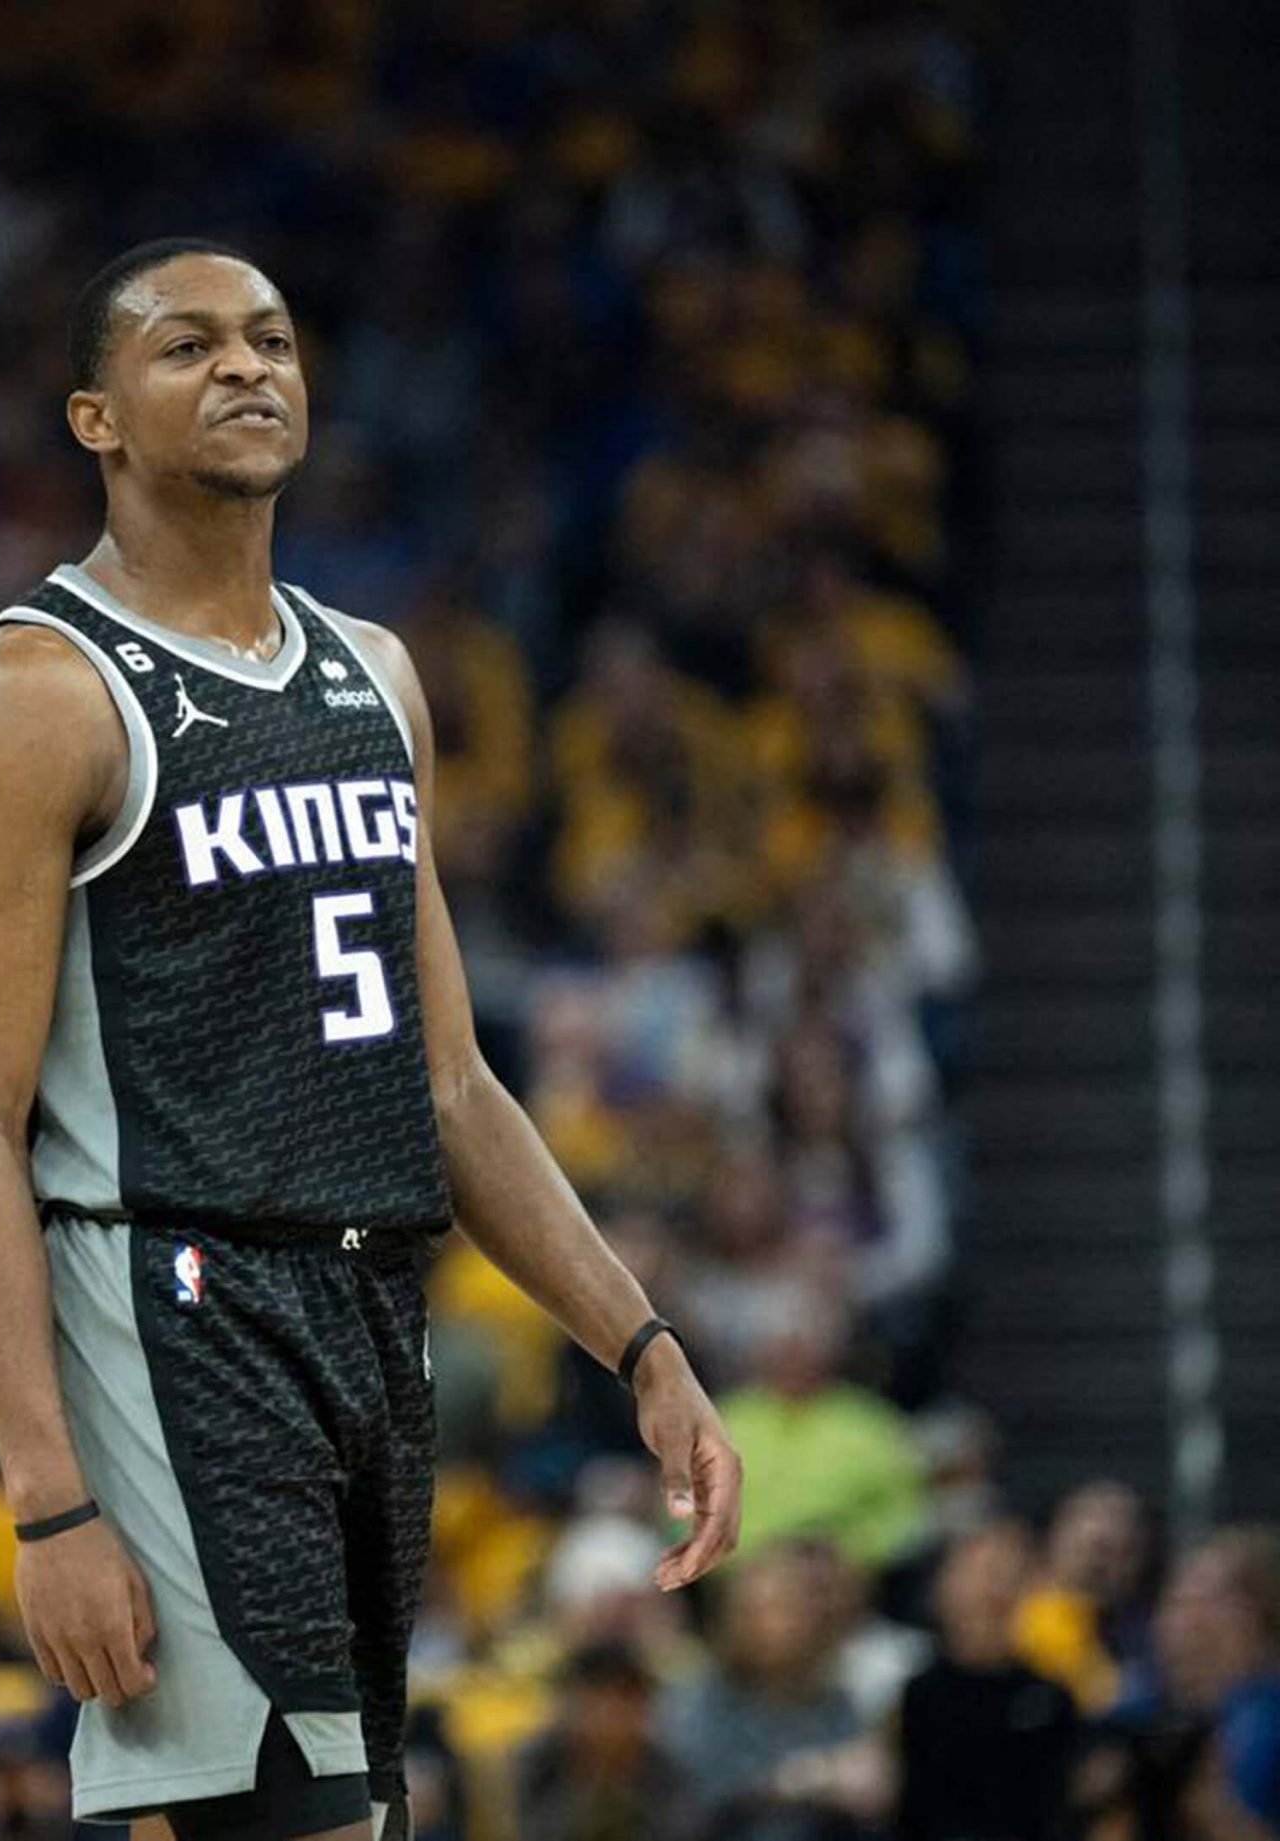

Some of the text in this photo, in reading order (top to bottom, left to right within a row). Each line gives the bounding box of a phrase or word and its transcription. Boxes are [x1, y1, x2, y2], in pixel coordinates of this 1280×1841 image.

[115, 641, 156, 673] 6
[175, 778, 417, 886] KINGS
[312, 891, 394, 1041] 5
